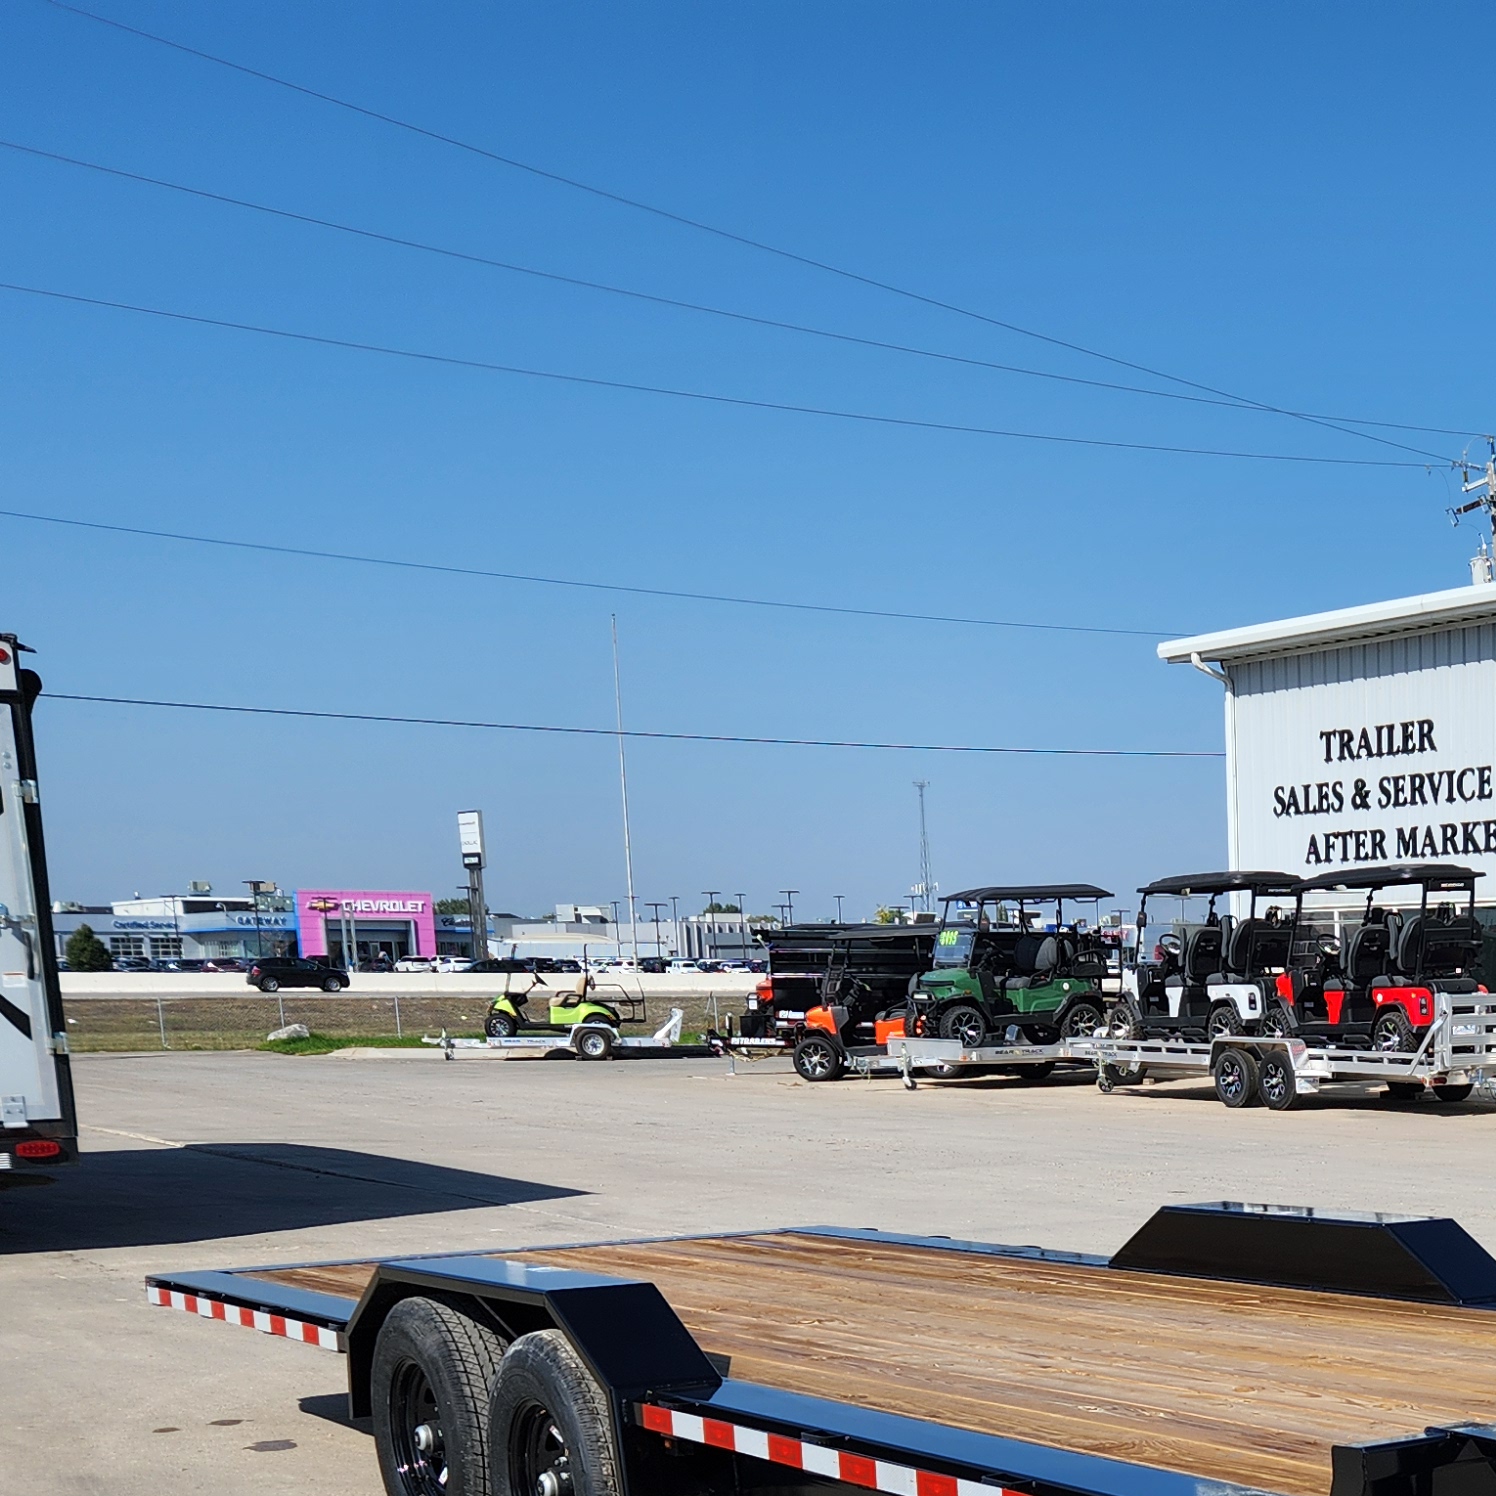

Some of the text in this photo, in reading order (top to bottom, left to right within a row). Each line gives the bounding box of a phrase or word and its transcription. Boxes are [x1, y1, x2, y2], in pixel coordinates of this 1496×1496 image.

[1320, 719, 1437, 764] TRAILER
[1273, 765, 1493, 818] SALES & SERVICE
[1305, 826, 1387, 865] AFTER
[236, 916, 287, 926] GATEWAY
[341, 899, 425, 913] CHEVROLET
